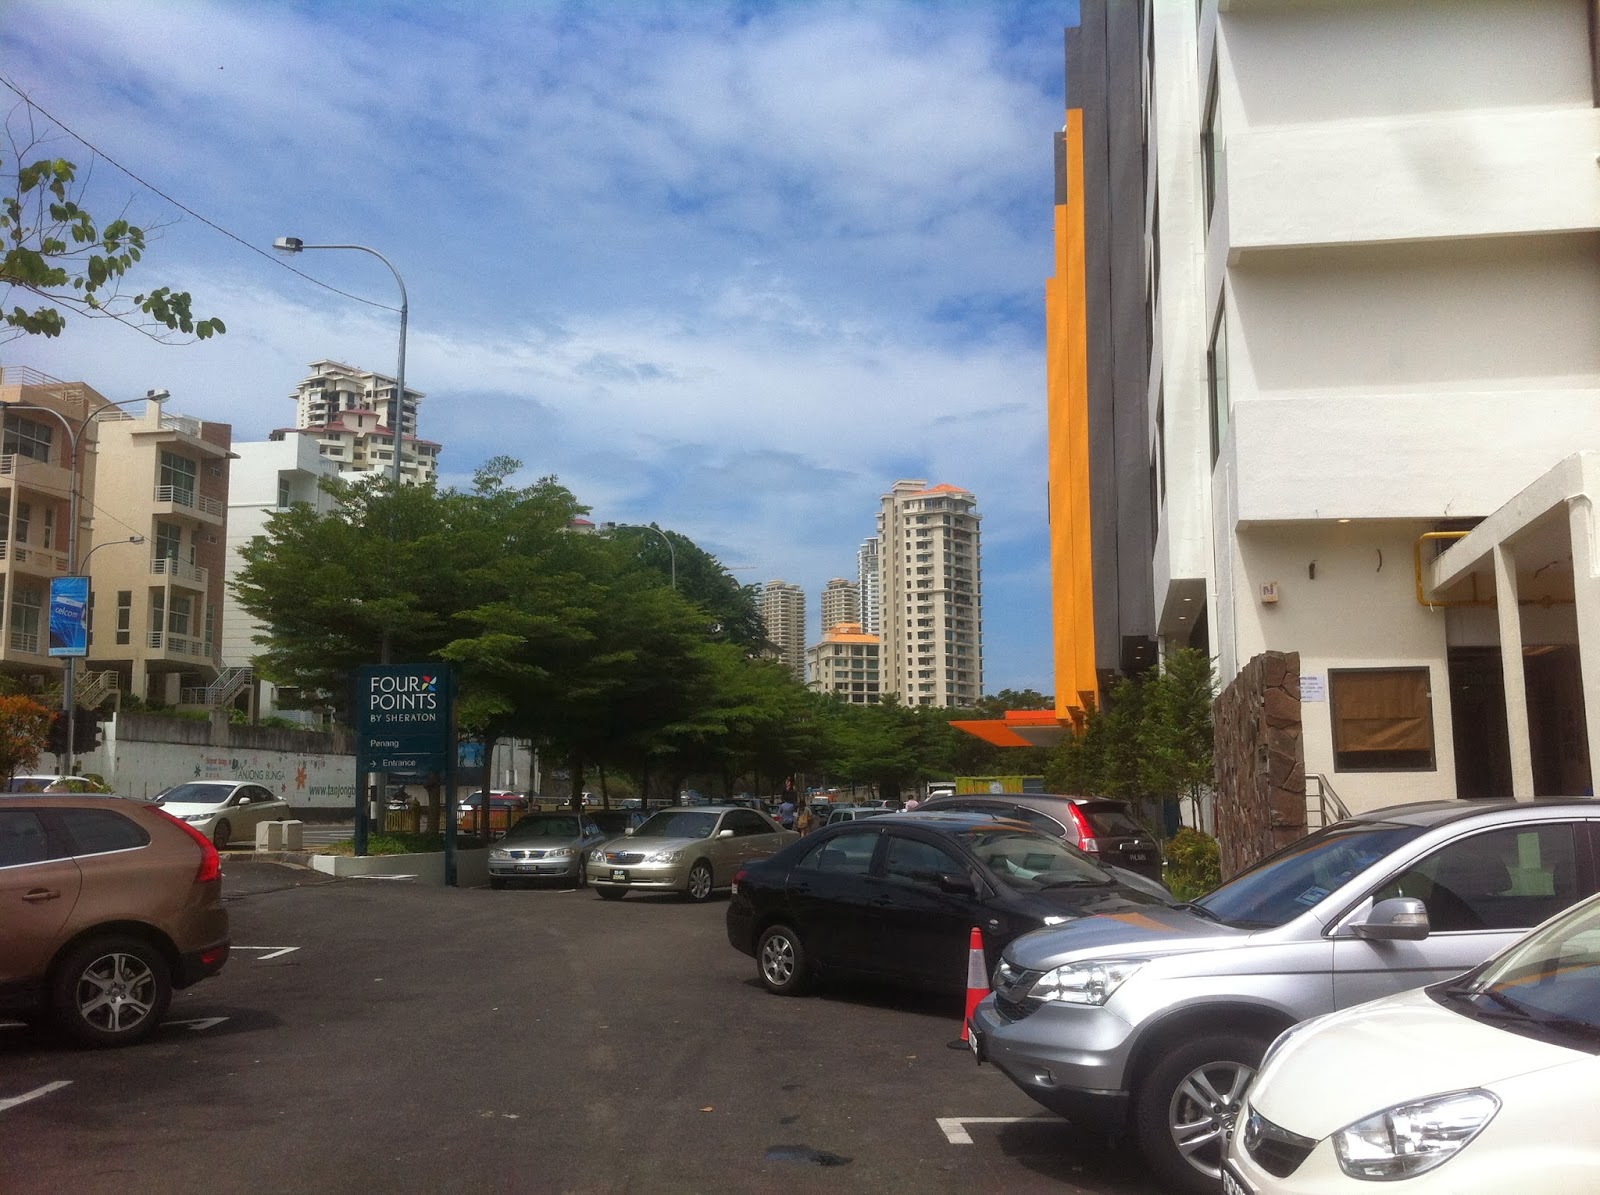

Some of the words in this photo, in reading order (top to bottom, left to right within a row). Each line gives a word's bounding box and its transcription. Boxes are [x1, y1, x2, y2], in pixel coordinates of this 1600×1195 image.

[55, 606, 78, 618] celcom
[370, 676, 420, 693] FOUR
[370, 693, 437, 710] POINTS
[370, 714, 382, 723] BY
[385, 713, 436, 722] SHERATON
[370, 739, 399, 748] Penang
[382, 759, 416, 767] Entrance
[234, 769, 264, 781] TANJONG
[265, 770, 286, 781] BUNGA
